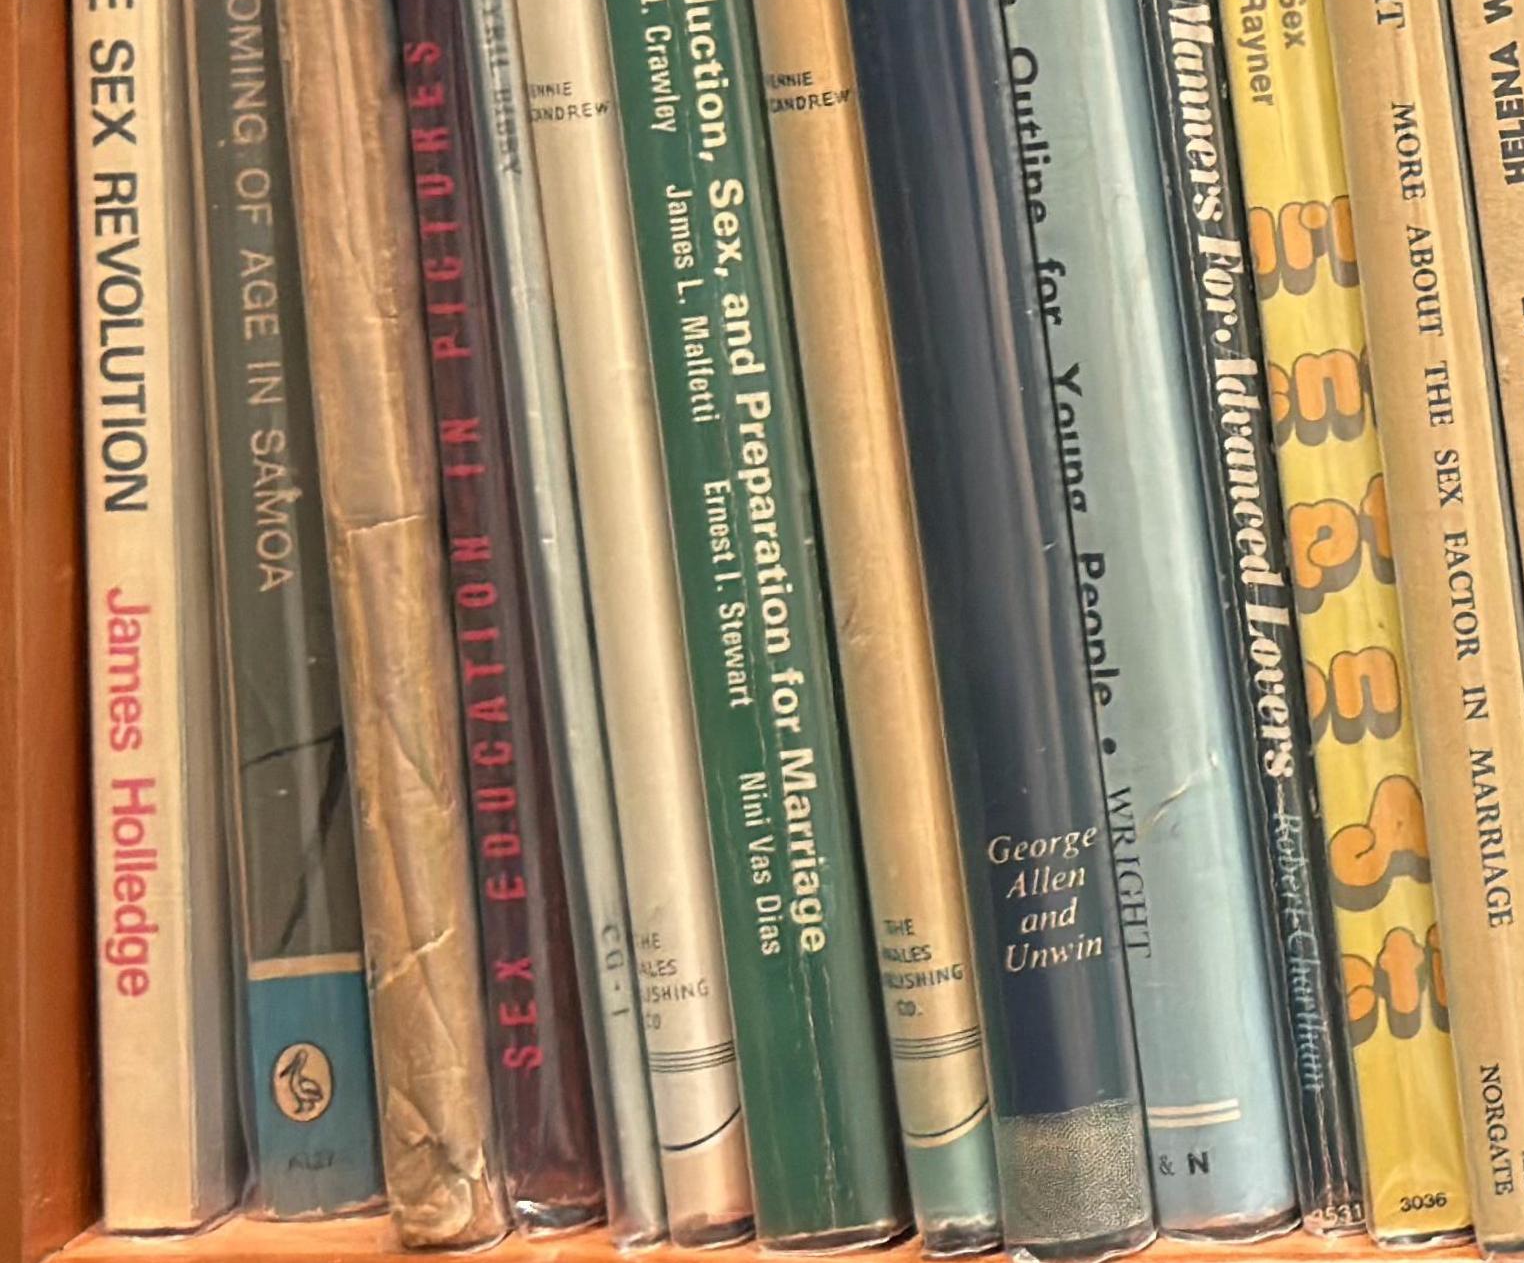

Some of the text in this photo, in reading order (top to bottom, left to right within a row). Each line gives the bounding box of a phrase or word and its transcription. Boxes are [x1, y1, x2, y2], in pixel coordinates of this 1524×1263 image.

[88, 39, 137, 145] SEX
[643, 25, 676, 134] Crawley
[236, 168, 272, 221] OF
[667, 185, 694, 273] James
[239, 249, 280, 340] AGE
[676, 279, 703, 306] L.
[94, 172, 148, 513] REVOLUTION
[247, 361, 285, 405] IN
[251, 430, 295, 591] SAMOA
[703, 479, 731, 566] Ernest
[105, 588, 151, 752] James
[719, 602, 753, 708] Stewart
[739, 771, 766, 834] Nini
[748, 843, 772, 885] Vas
[988, 827, 1098, 864] George
[111, 777, 158, 998] Holledge
[1007, 866, 1086, 900] Allen
[754, 894, 780, 957] Dias
[1021, 902, 1079, 935] and
[1005, 935, 1104, 972] Unwin
[1400, 1193, 1447, 1213] 3036
